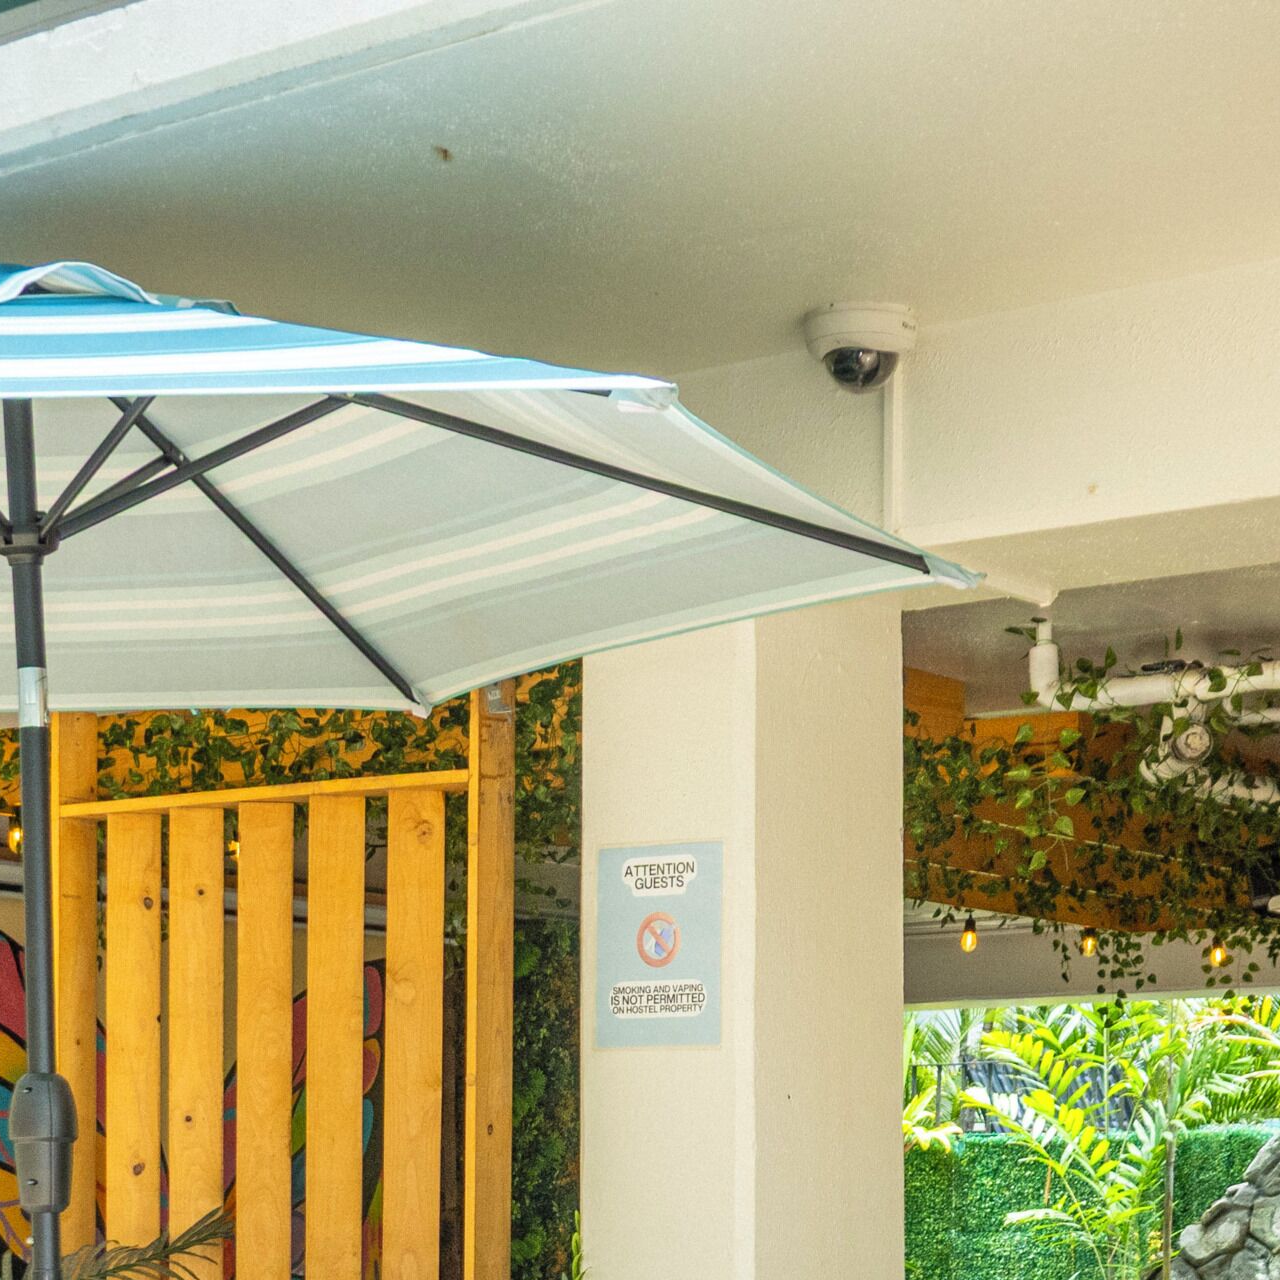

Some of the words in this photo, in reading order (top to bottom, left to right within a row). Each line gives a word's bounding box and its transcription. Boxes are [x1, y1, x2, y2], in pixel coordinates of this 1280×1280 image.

[624, 861, 695, 877] ATTENTION
[634, 875, 684, 890] GUESTS
[613, 985, 651, 995] SMOKING
[653, 985, 671, 993] AND
[672, 984, 703, 993] VAPING
[611, 995, 620, 1006] IS
[622, 994, 645, 1005] NOT
[646, 992, 705, 1004] PERMITTED
[613, 1005, 624, 1014] ON
[626, 1004, 658, 1014] HOSTEL
[659, 1003, 703, 1013] PROPERTY
